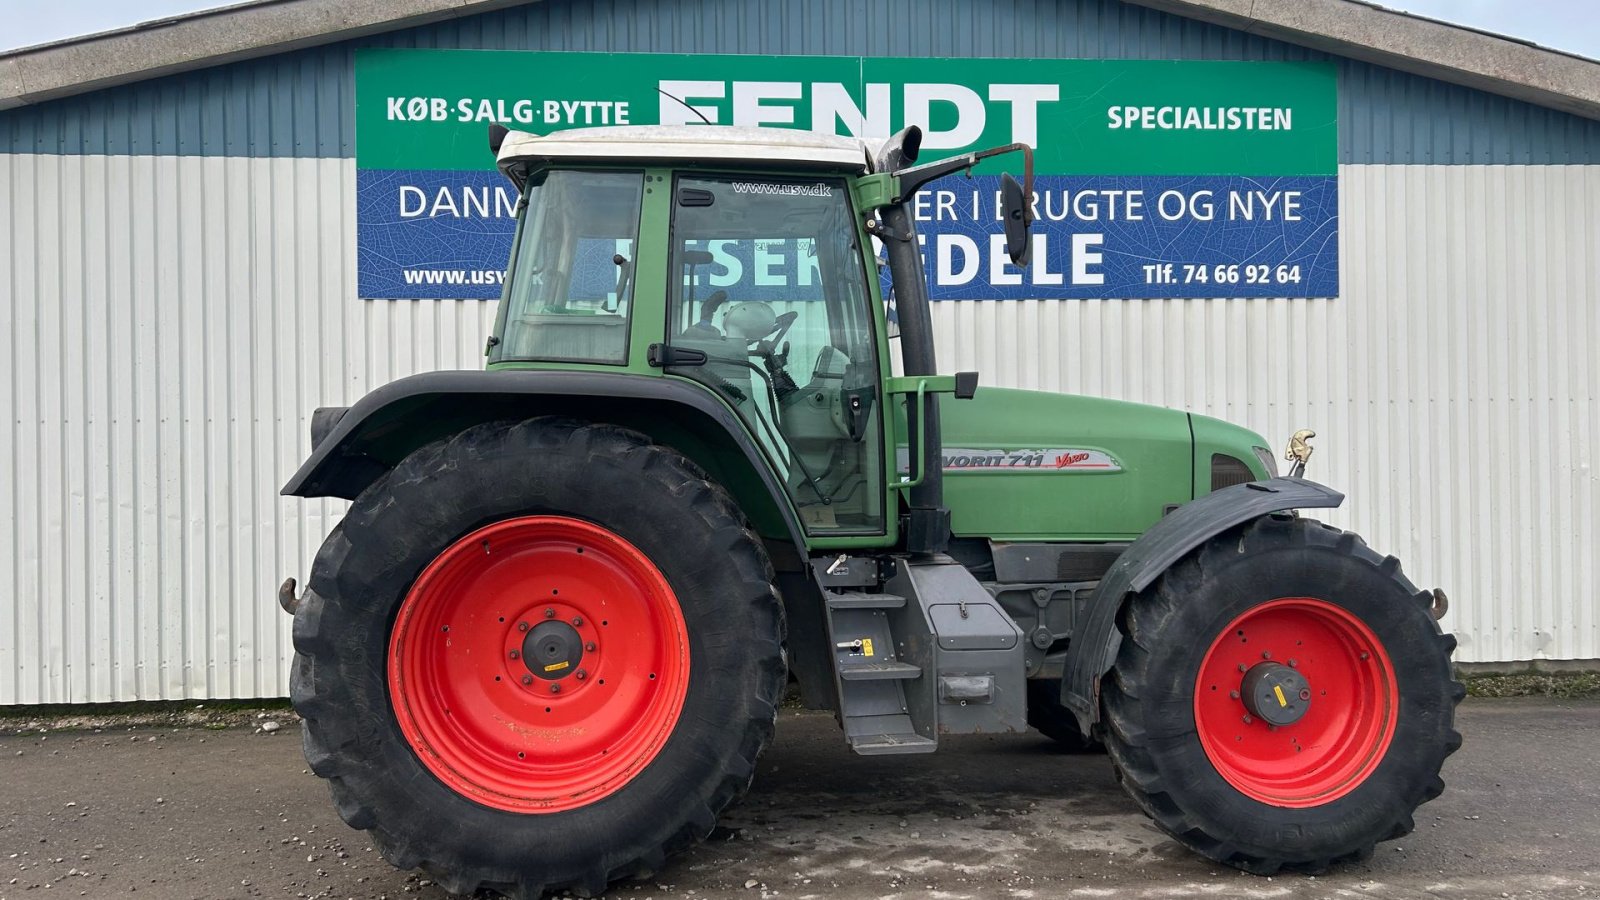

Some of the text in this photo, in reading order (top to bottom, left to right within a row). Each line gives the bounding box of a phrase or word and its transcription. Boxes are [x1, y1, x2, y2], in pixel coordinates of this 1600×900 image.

[659, 80, 1060, 150] FENDT
[1107, 106, 1292, 130] SPECIALISTEN
[732, 182, 832, 197] www.usv.dk
[973, 190, 979, 221] I
[1158, 189, 1214, 221] OG
[1229, 189, 1301, 221] NYE
[1142, 263, 1302, 284] Tlf. 74 66 92 64
[1008, 454, 1044, 467] 711
